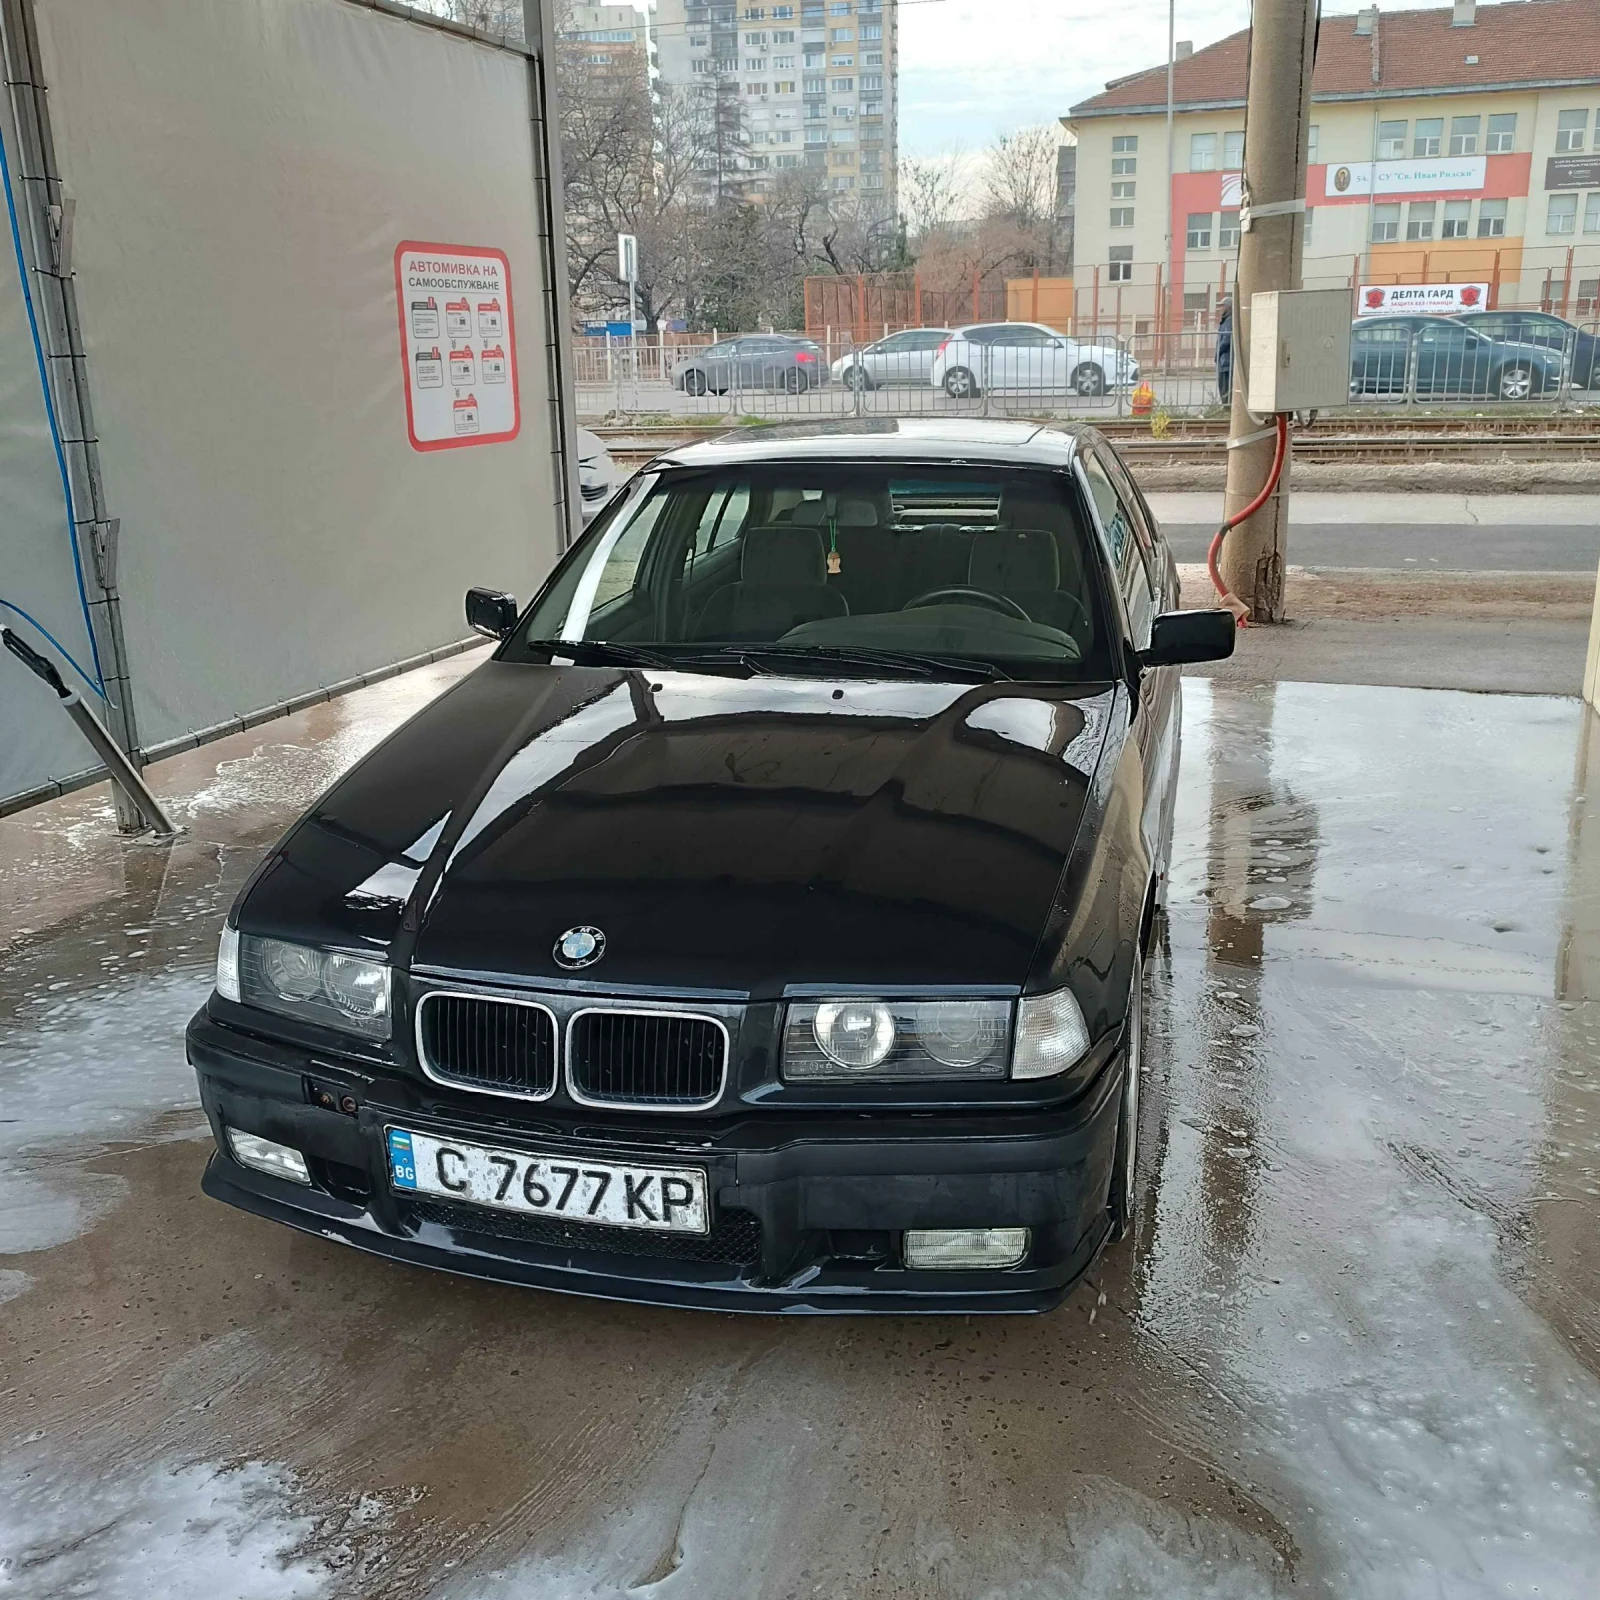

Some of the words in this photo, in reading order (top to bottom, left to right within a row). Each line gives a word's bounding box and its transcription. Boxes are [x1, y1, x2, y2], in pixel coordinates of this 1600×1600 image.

[409, 260, 480, 276] АВТОМИВКА
[483, 265, 498, 276] НА
[408, 277, 500, 290] САМООБСЛУЖВАНЕ
[1391, 290, 1425, 300] ДЕЛТА
[1427, 289, 1454, 299] ГАРД
[395, 1164, 415, 1180] BG
[488, 1155, 612, 1215] 7677
